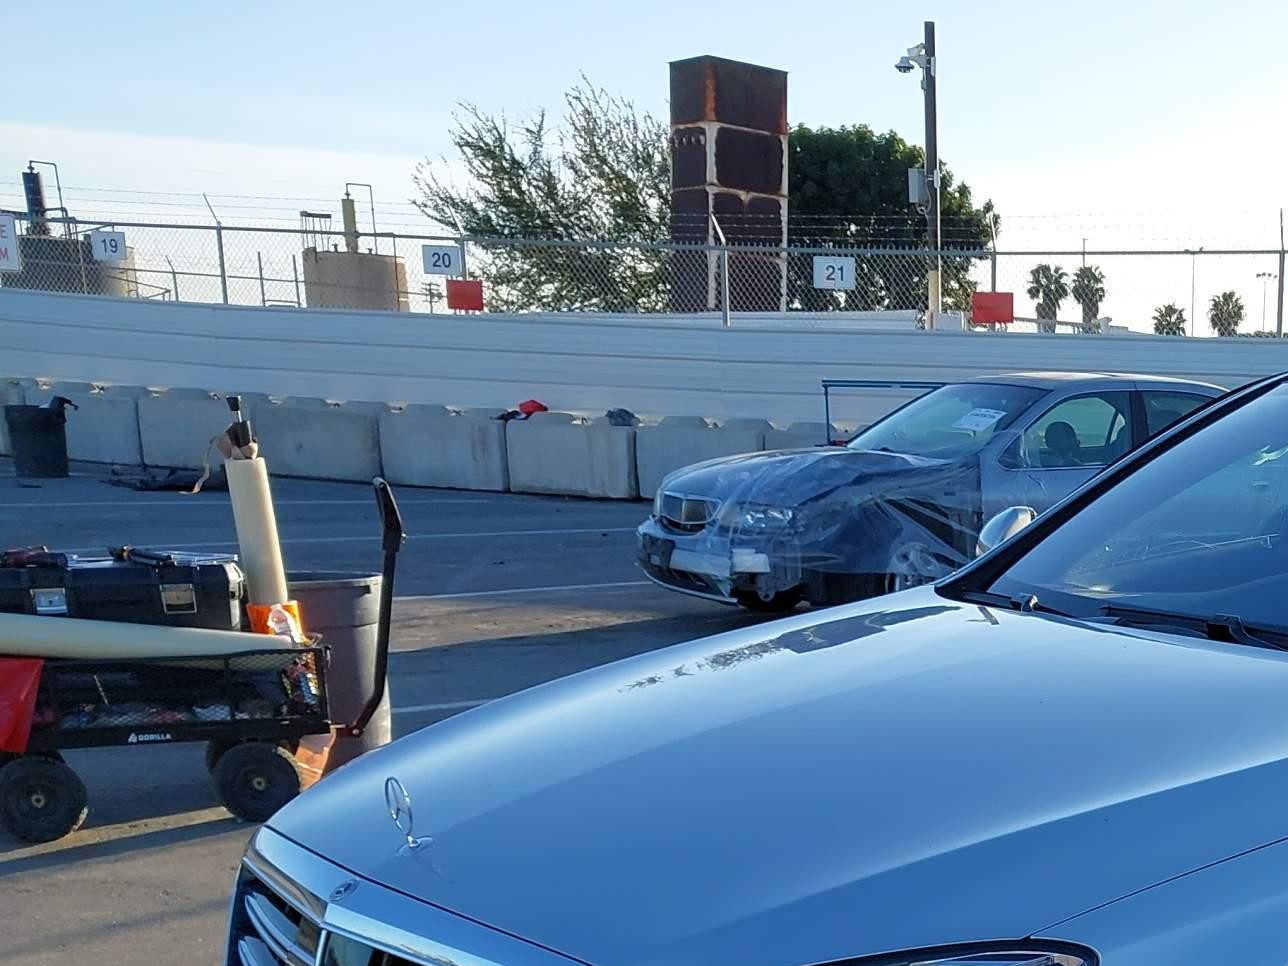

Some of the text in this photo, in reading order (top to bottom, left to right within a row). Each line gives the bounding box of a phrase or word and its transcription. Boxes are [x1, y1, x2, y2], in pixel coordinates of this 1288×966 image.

[101, 238, 118, 253] 19
[431, 252, 452, 268] 20
[825, 264, 844, 281] 21
